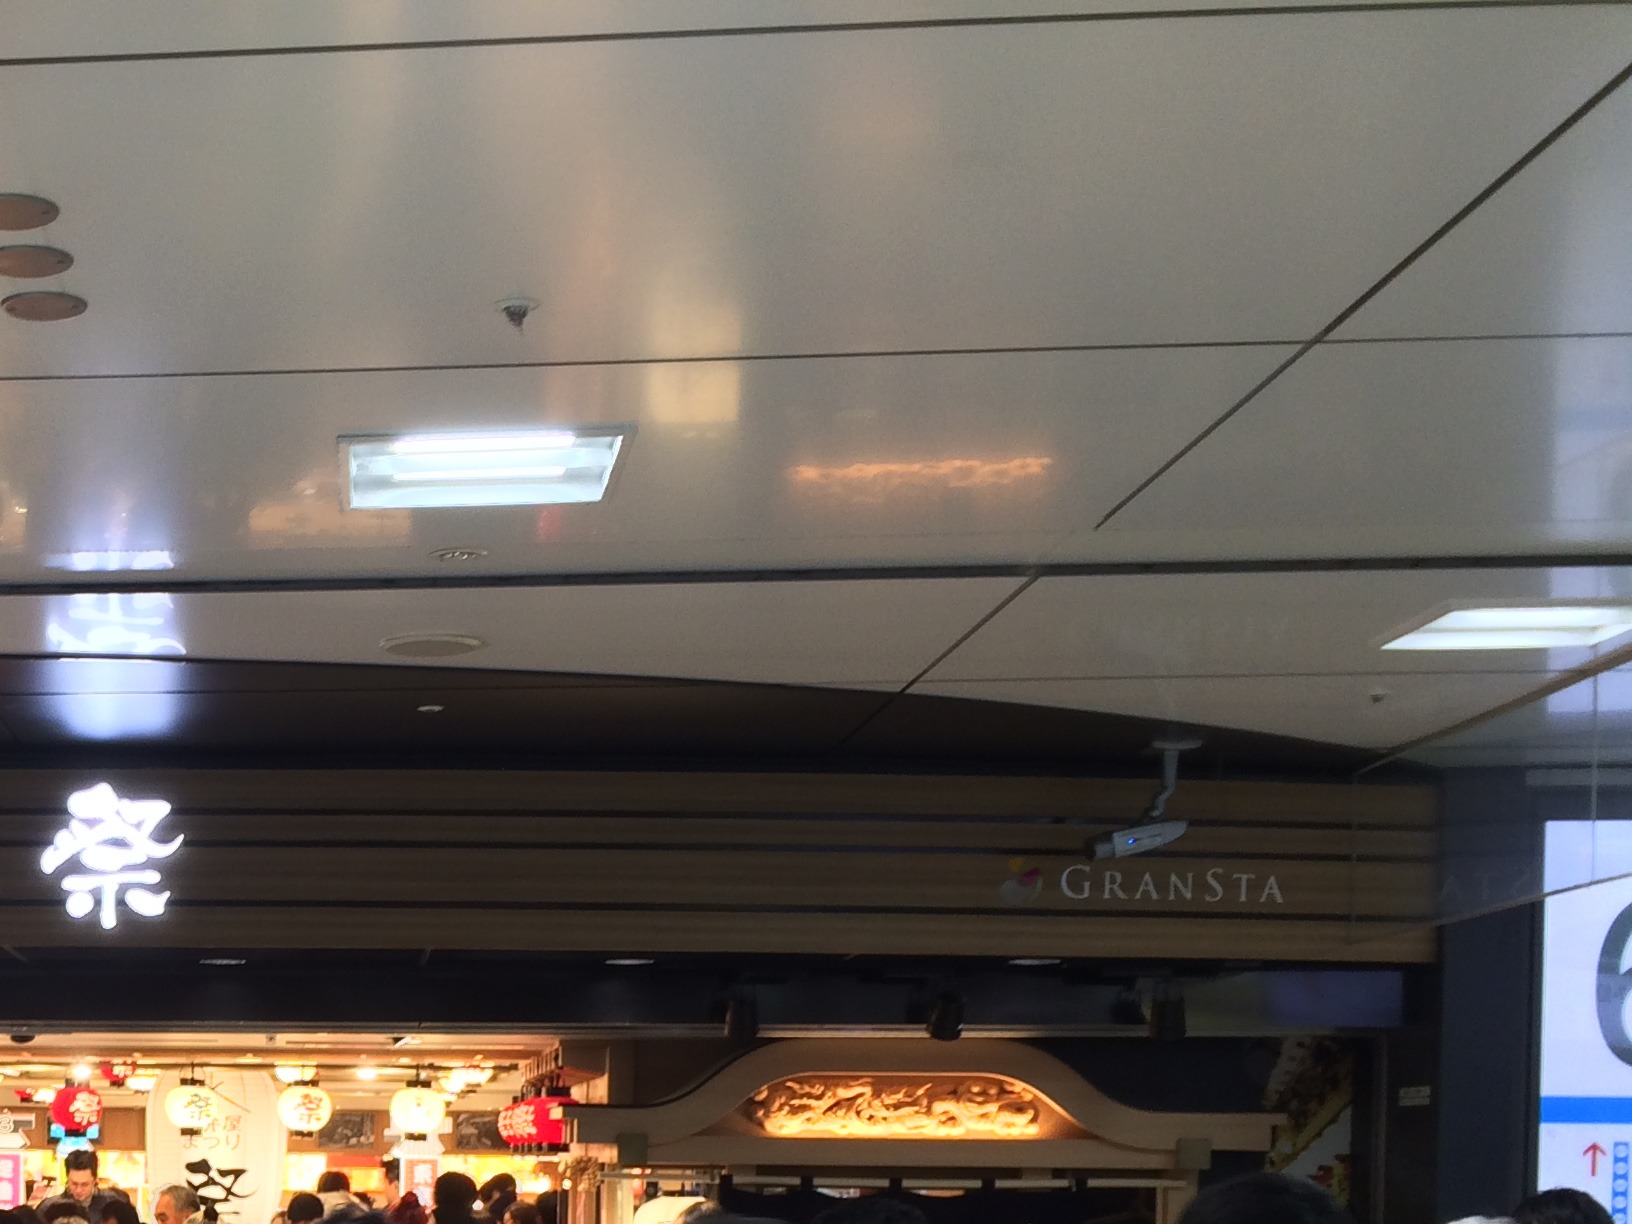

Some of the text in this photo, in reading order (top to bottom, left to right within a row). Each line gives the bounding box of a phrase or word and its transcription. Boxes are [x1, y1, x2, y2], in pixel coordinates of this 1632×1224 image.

[39, 781, 186, 931] 祭
[68, 1091, 103, 1126] 祭
[294, 1092, 324, 1125] 祭
[183, 1135, 242, 1151] まつり
